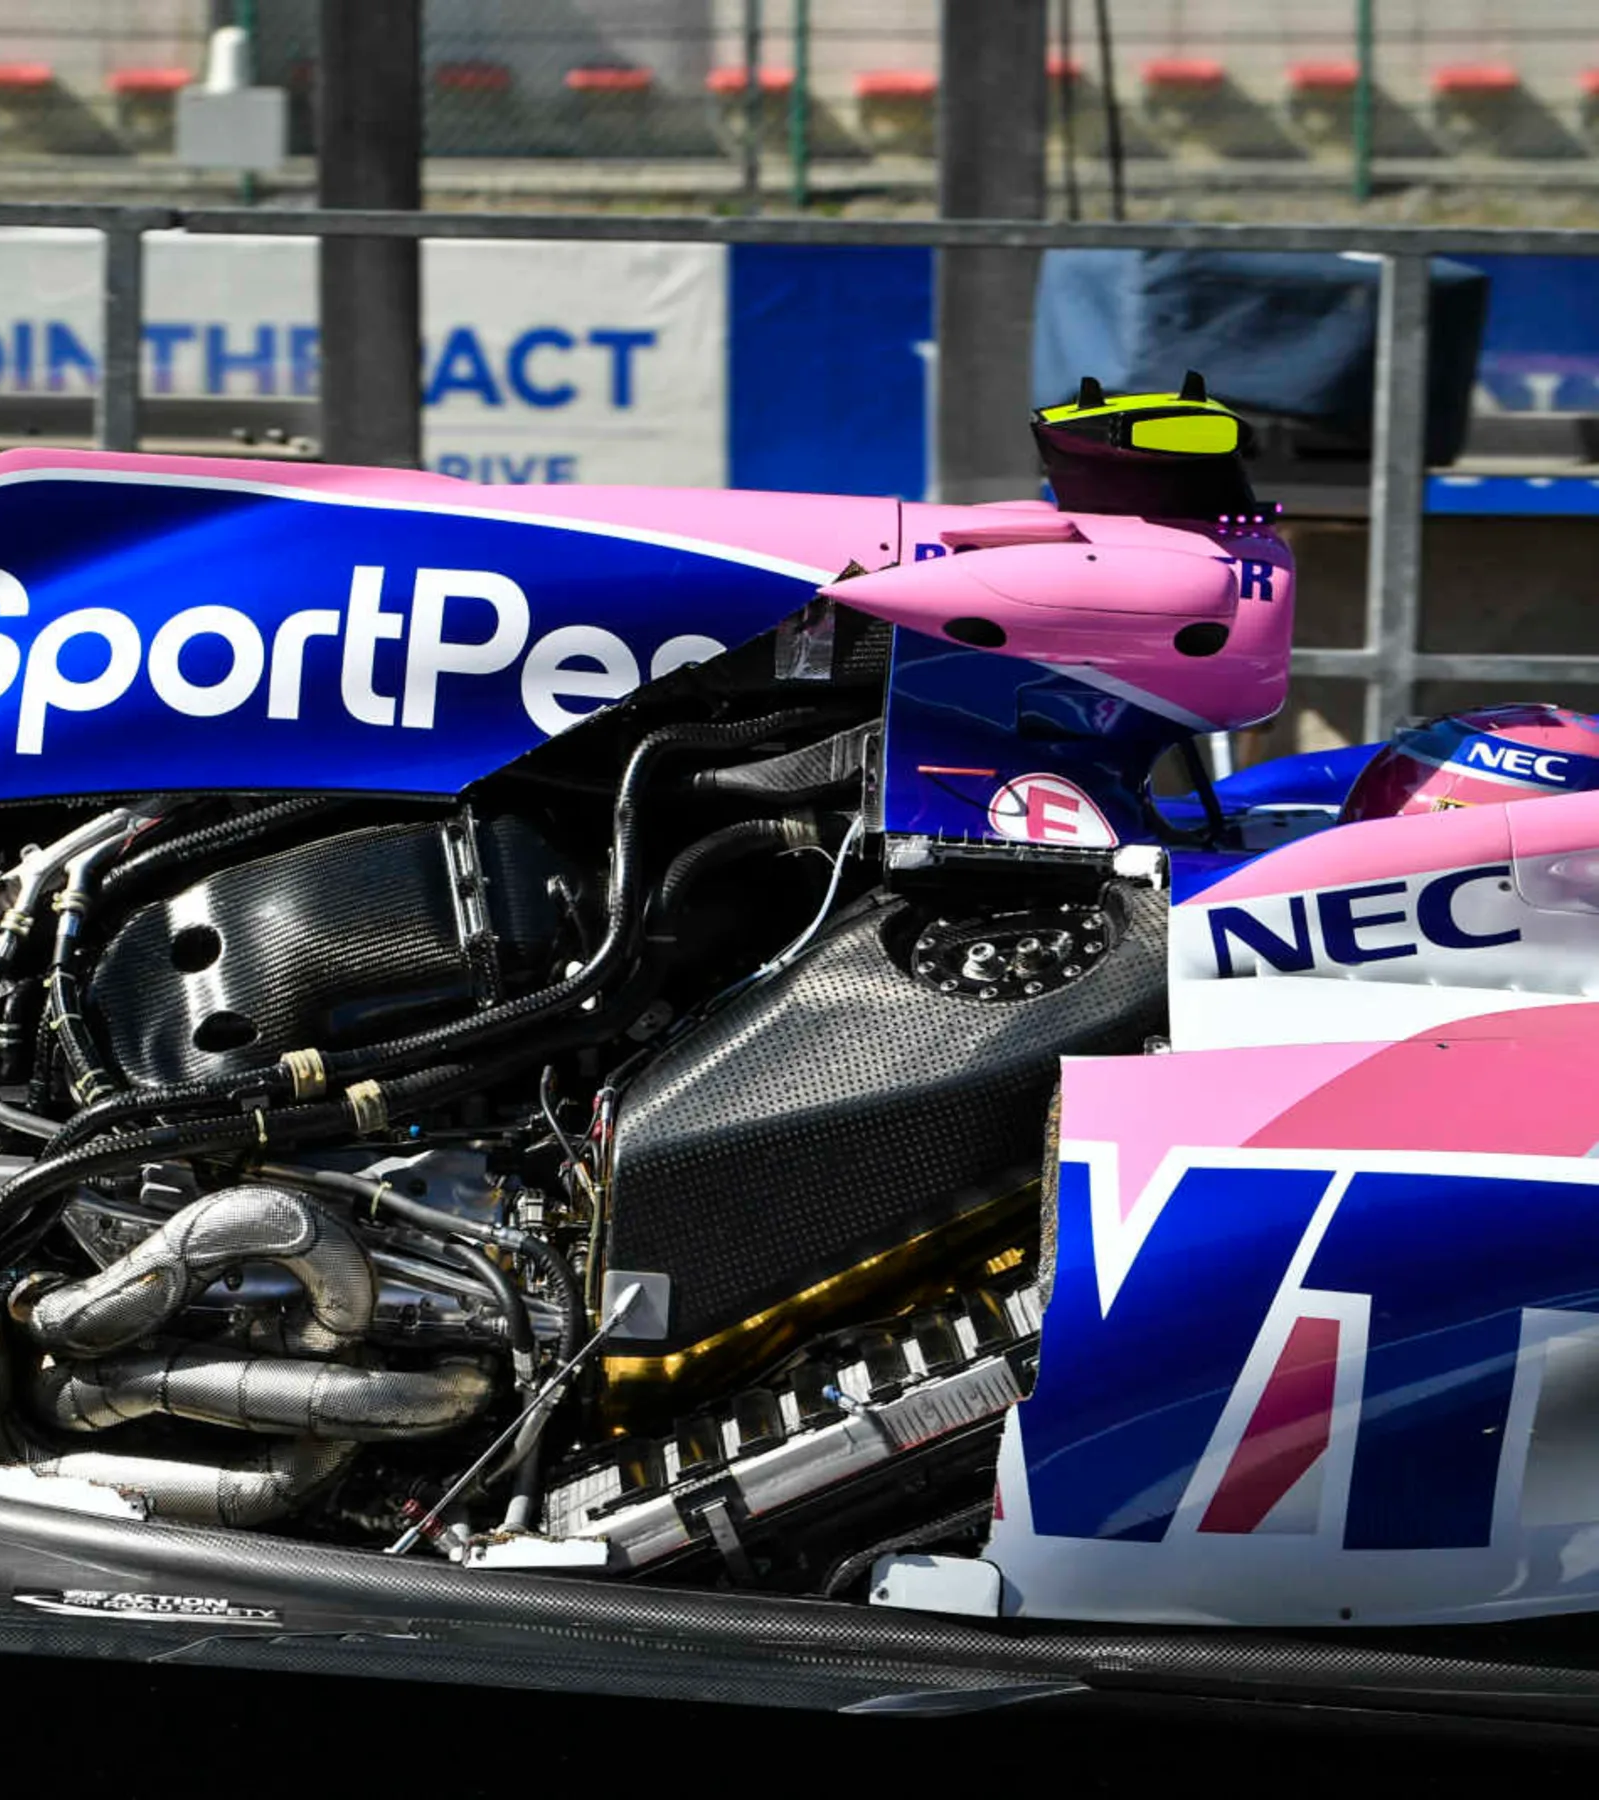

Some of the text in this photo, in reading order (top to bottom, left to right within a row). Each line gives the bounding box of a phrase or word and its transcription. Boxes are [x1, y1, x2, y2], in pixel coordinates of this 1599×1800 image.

[420, 325, 657, 409] ACT
[436, 454, 579, 485] RIVE
[1467, 742, 1569, 782] NEC
[1207, 865, 1522, 979] NEC
[103, 1601, 172, 1612] ROAD
[178, 1604, 276, 1618] SAFETY
[110, 1592, 229, 1608] ACTION
